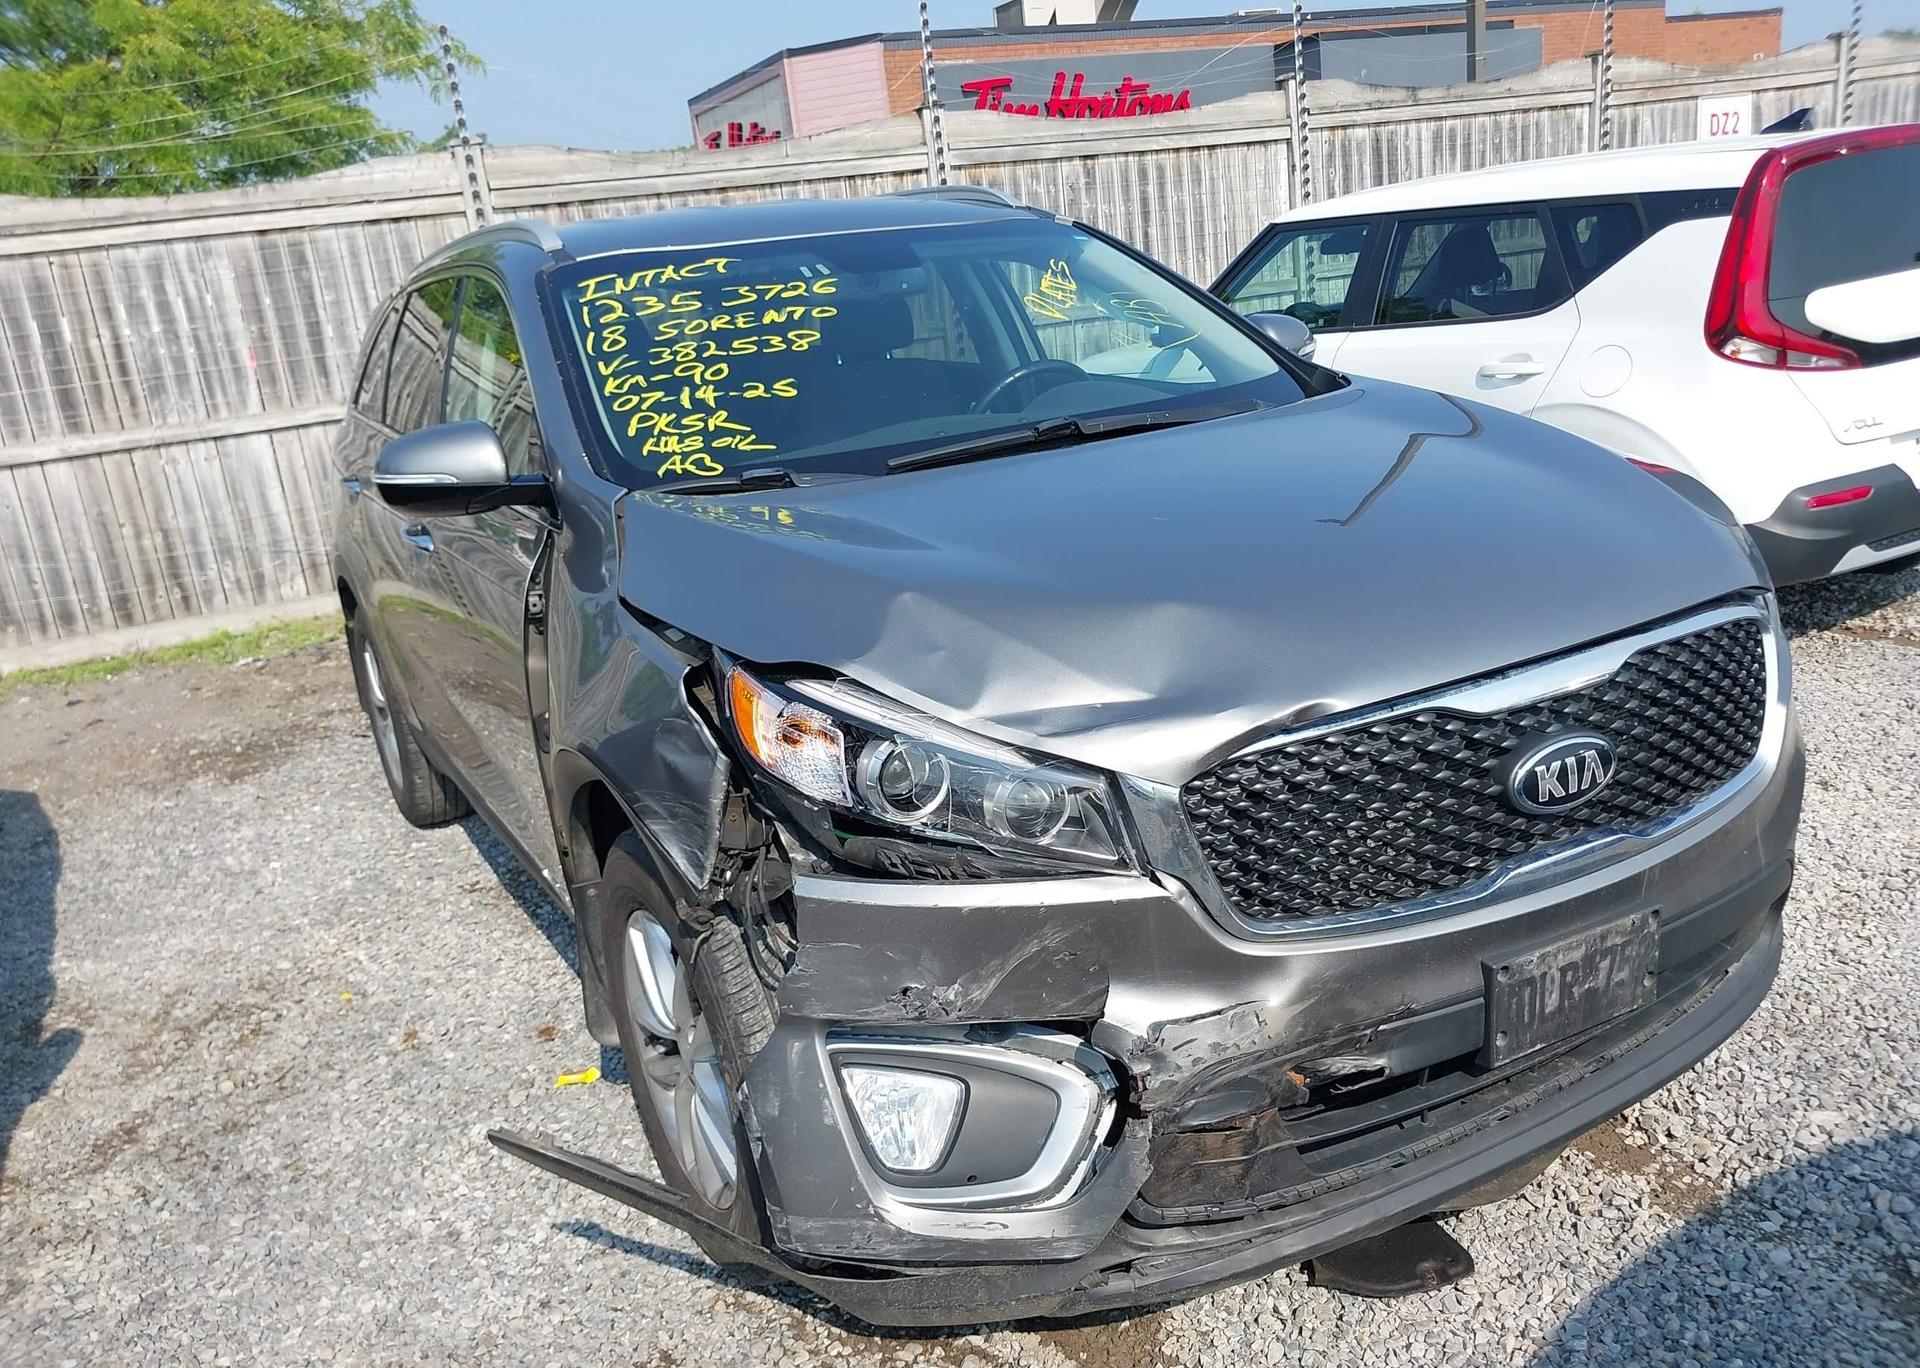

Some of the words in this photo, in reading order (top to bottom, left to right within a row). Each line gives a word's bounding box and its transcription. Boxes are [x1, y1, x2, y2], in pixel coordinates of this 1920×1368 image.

[1045, 70, 1191, 119] Hortons
[1710, 111, 1740, 136] DZ2
[577, 257, 742, 303] INTACT
[721, 277, 839, 307] 3726
[586, 325, 628, 356] 18
[654, 306, 838, 341] SORENTO
[1535, 749, 1605, 803] KIA
